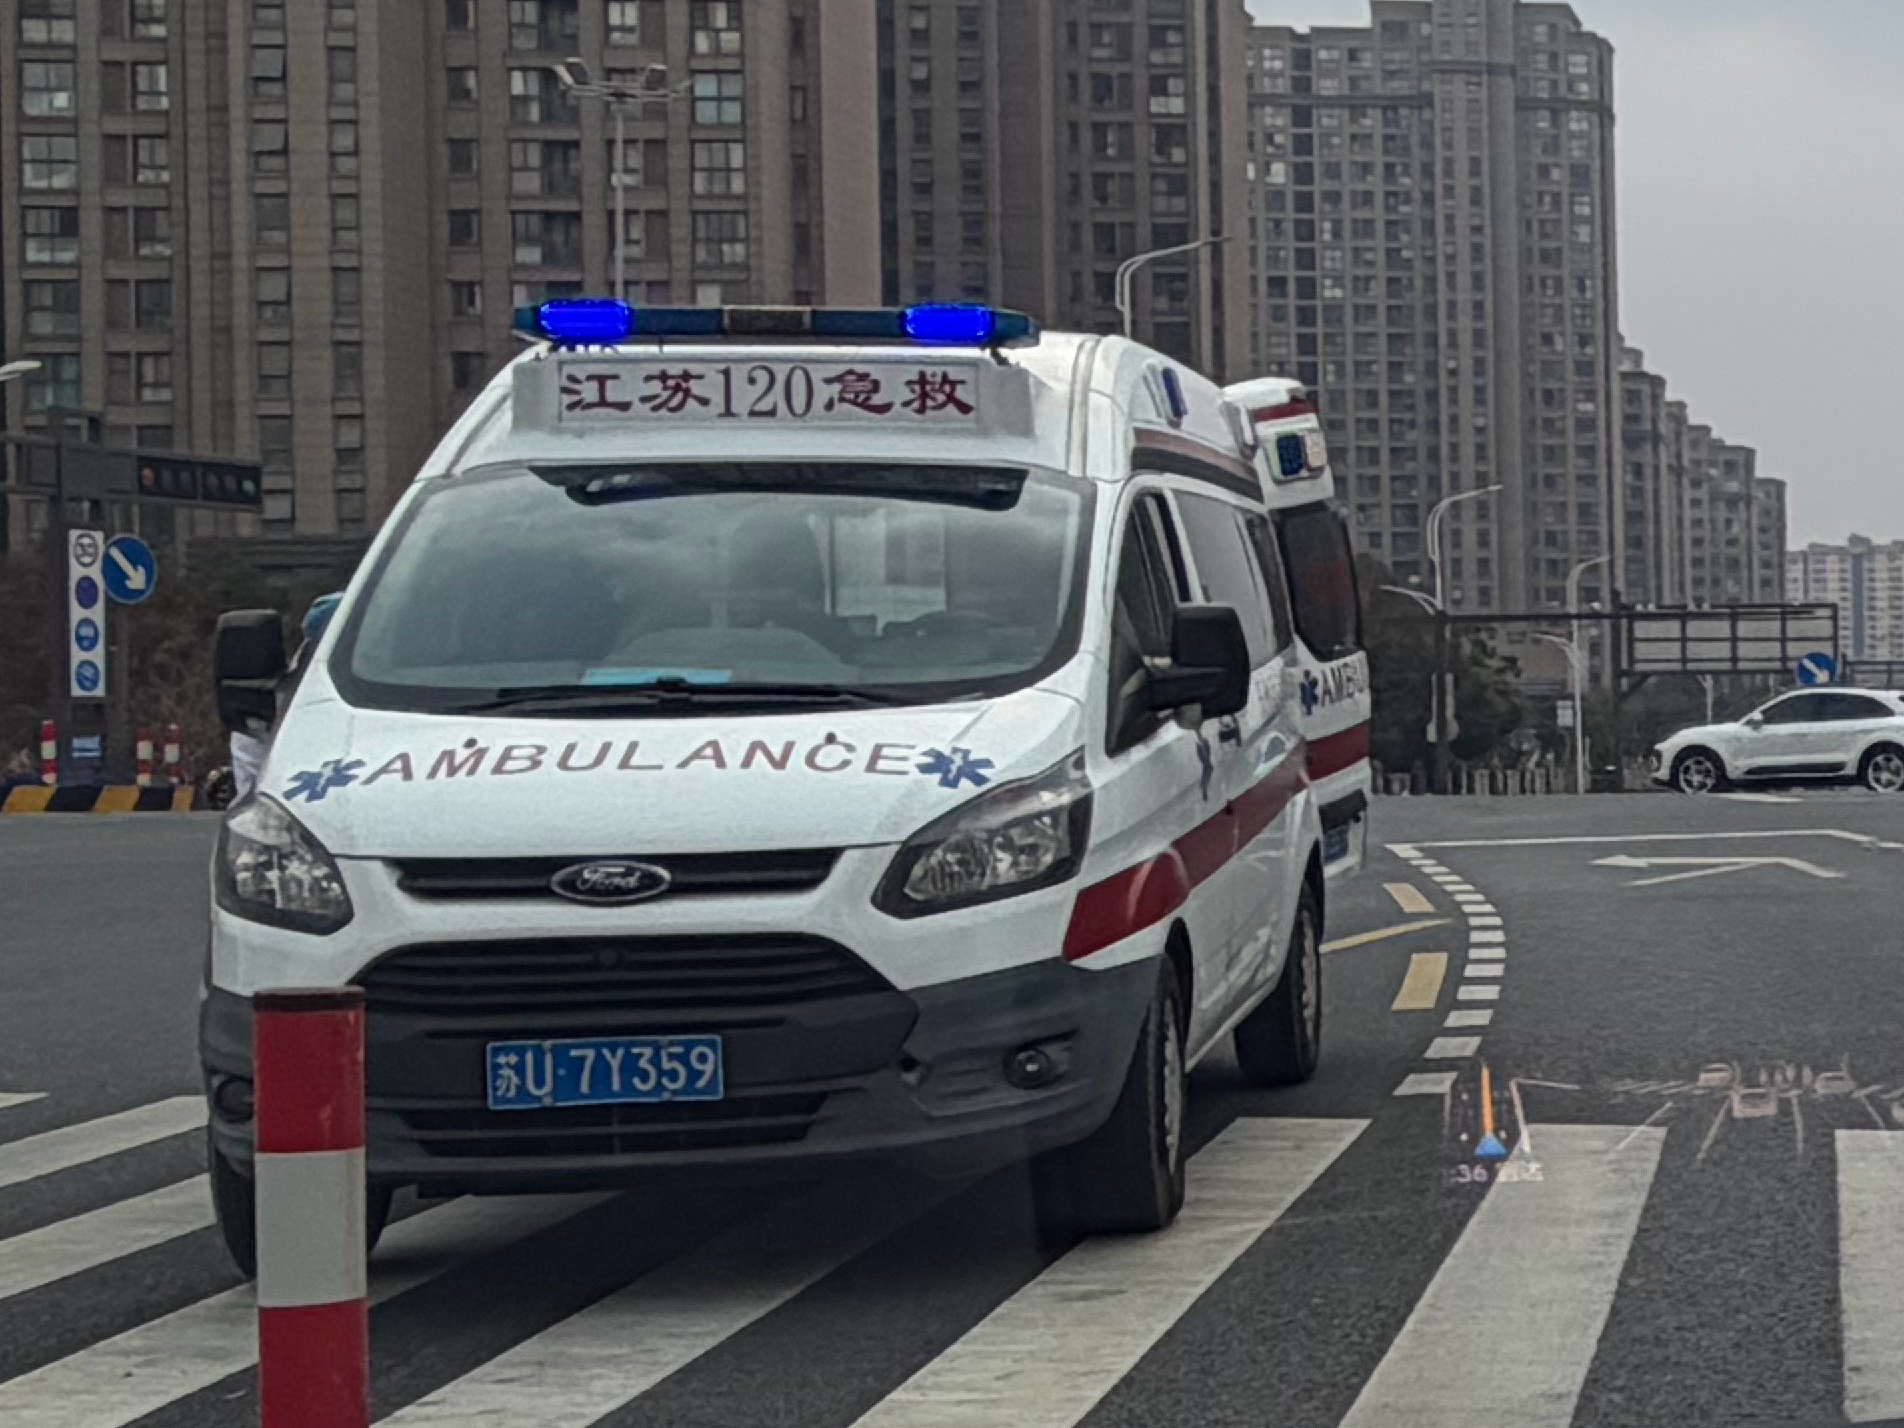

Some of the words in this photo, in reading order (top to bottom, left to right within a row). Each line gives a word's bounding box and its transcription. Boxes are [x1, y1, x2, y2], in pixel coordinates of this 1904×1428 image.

[559, 365, 976, 419] 江苏120急救
[361, 738, 919, 786] AMBULANCE
[576, 865, 641, 891] Ford
